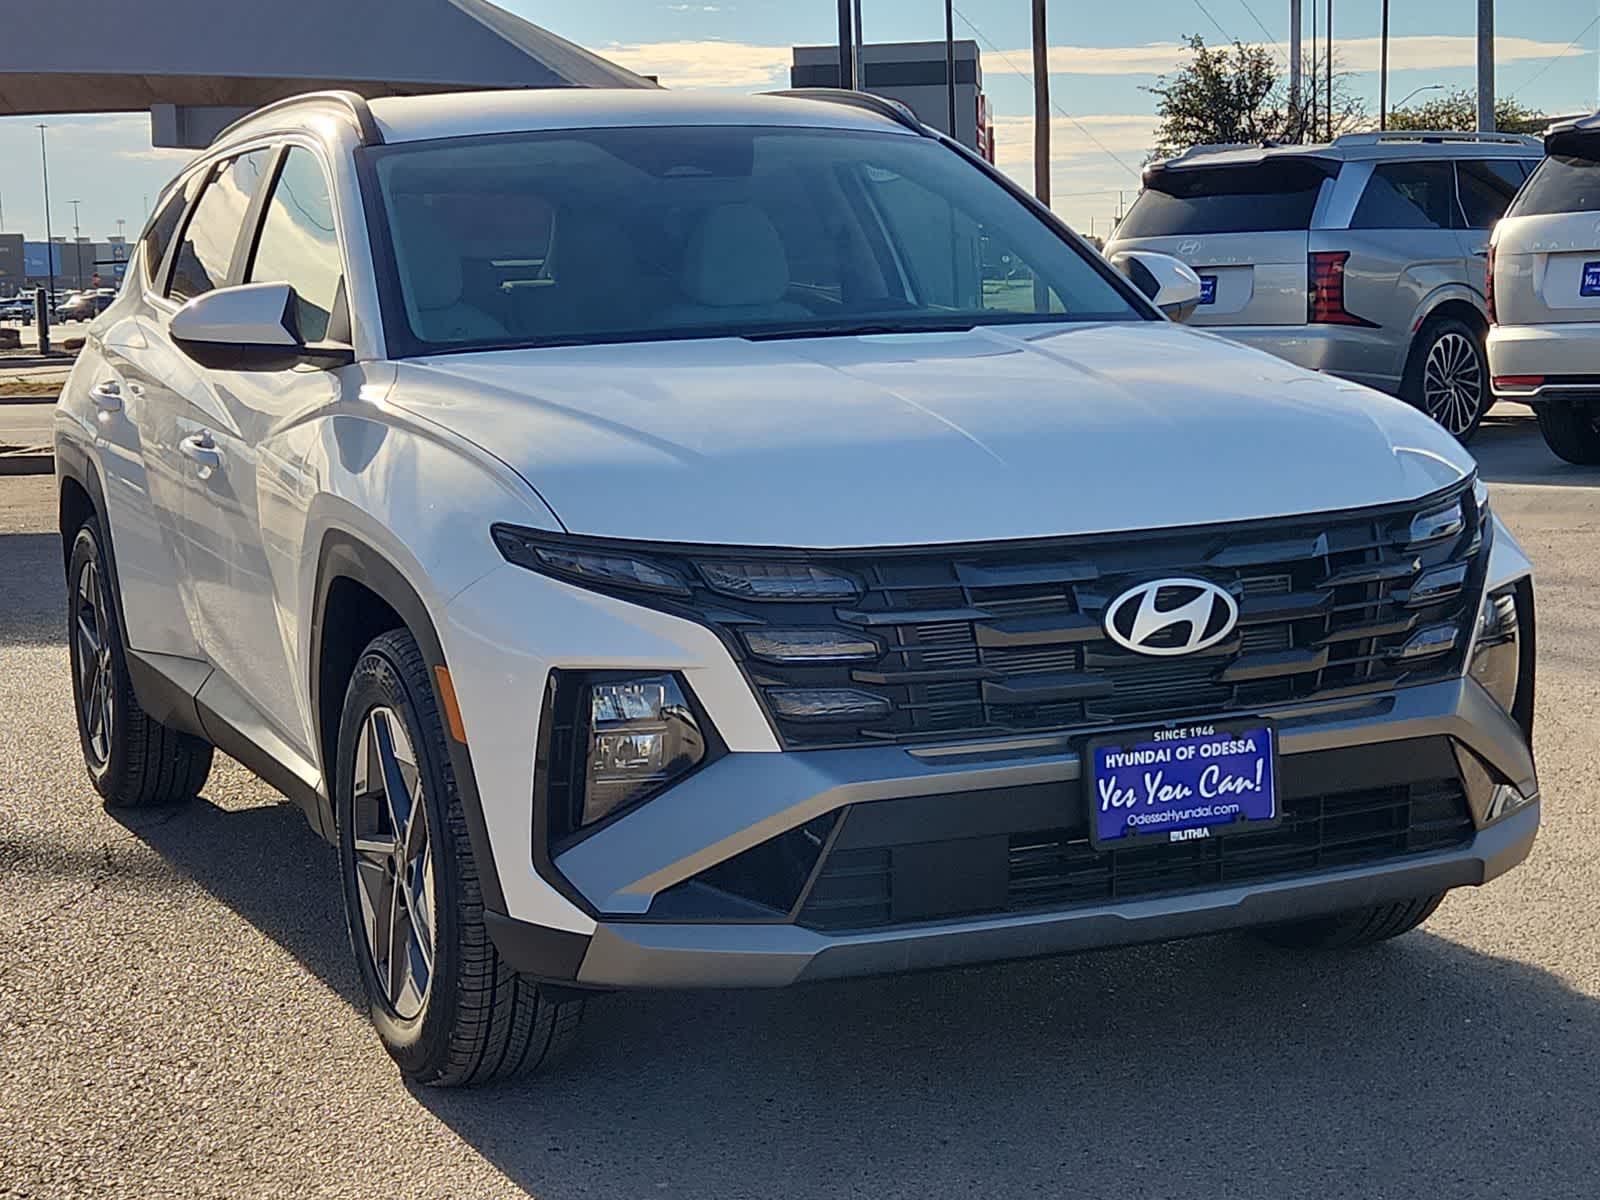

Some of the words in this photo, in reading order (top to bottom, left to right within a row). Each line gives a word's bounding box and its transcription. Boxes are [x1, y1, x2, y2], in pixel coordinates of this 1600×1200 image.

[1153, 728, 1187, 741] SINCE
[1190, 725, 1215, 737] 1946
[1105, 748, 1171, 769] HYUNDAI
[1175, 745, 1196, 760] OF
[1199, 738, 1257, 758] ODESSA
[1098, 775, 1137, 812] Yes
[1144, 770, 1193, 805] You
[1199, 757, 1264, 798] Can!
[1127, 804, 1240, 827] OdessaHyundai.com
[1179, 827, 1210, 841] LITHIA
